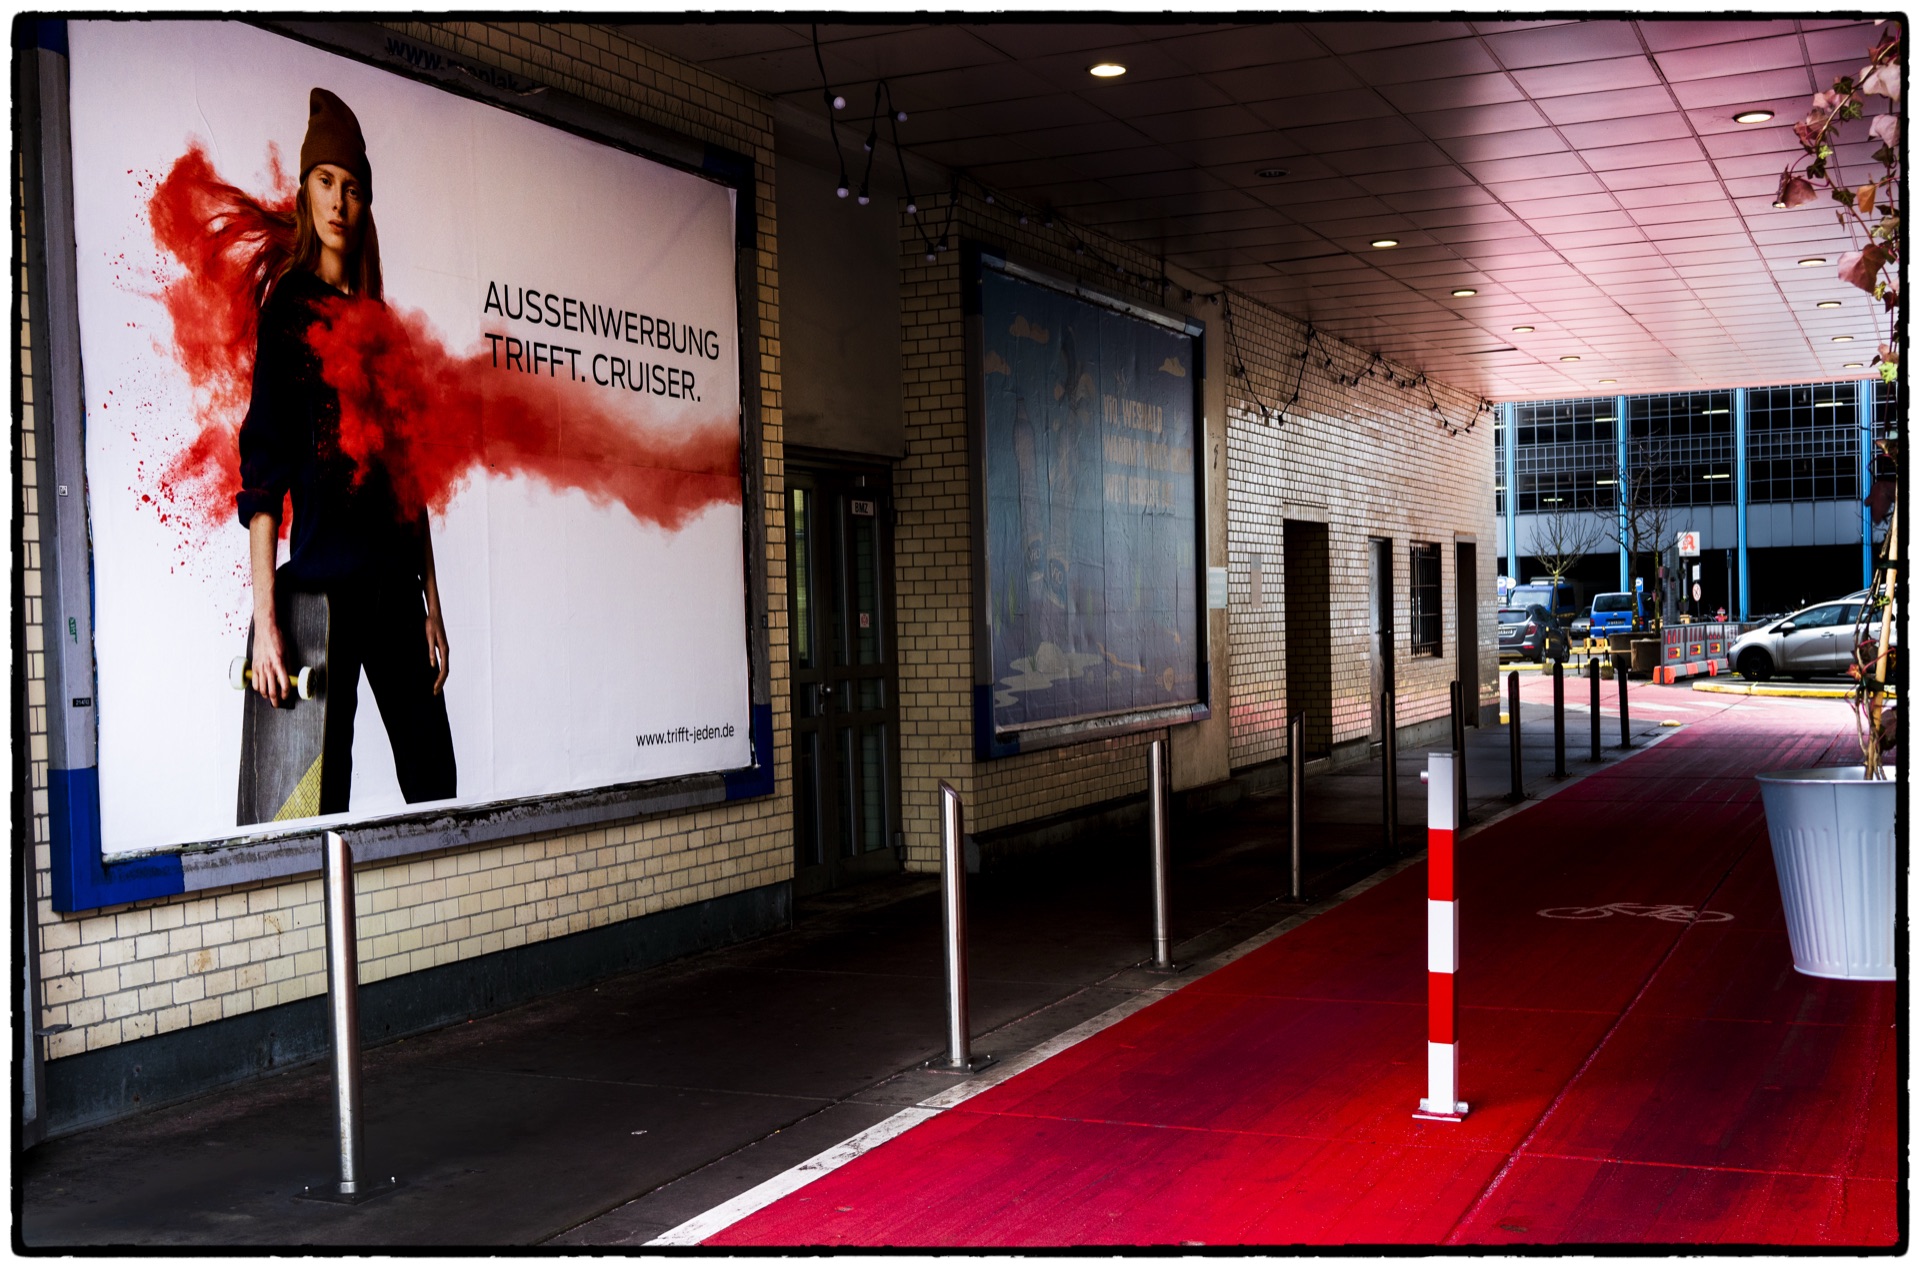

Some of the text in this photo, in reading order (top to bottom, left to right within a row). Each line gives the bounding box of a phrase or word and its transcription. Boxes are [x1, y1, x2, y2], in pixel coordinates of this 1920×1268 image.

[484, 281, 720, 360] AUSSENWERBUNG
[484, 332, 701, 402] TRIFFT. CRUISER.
[855, 502, 869, 514] BMZ
[636, 722, 735, 747] www.trifft-jeden.de
